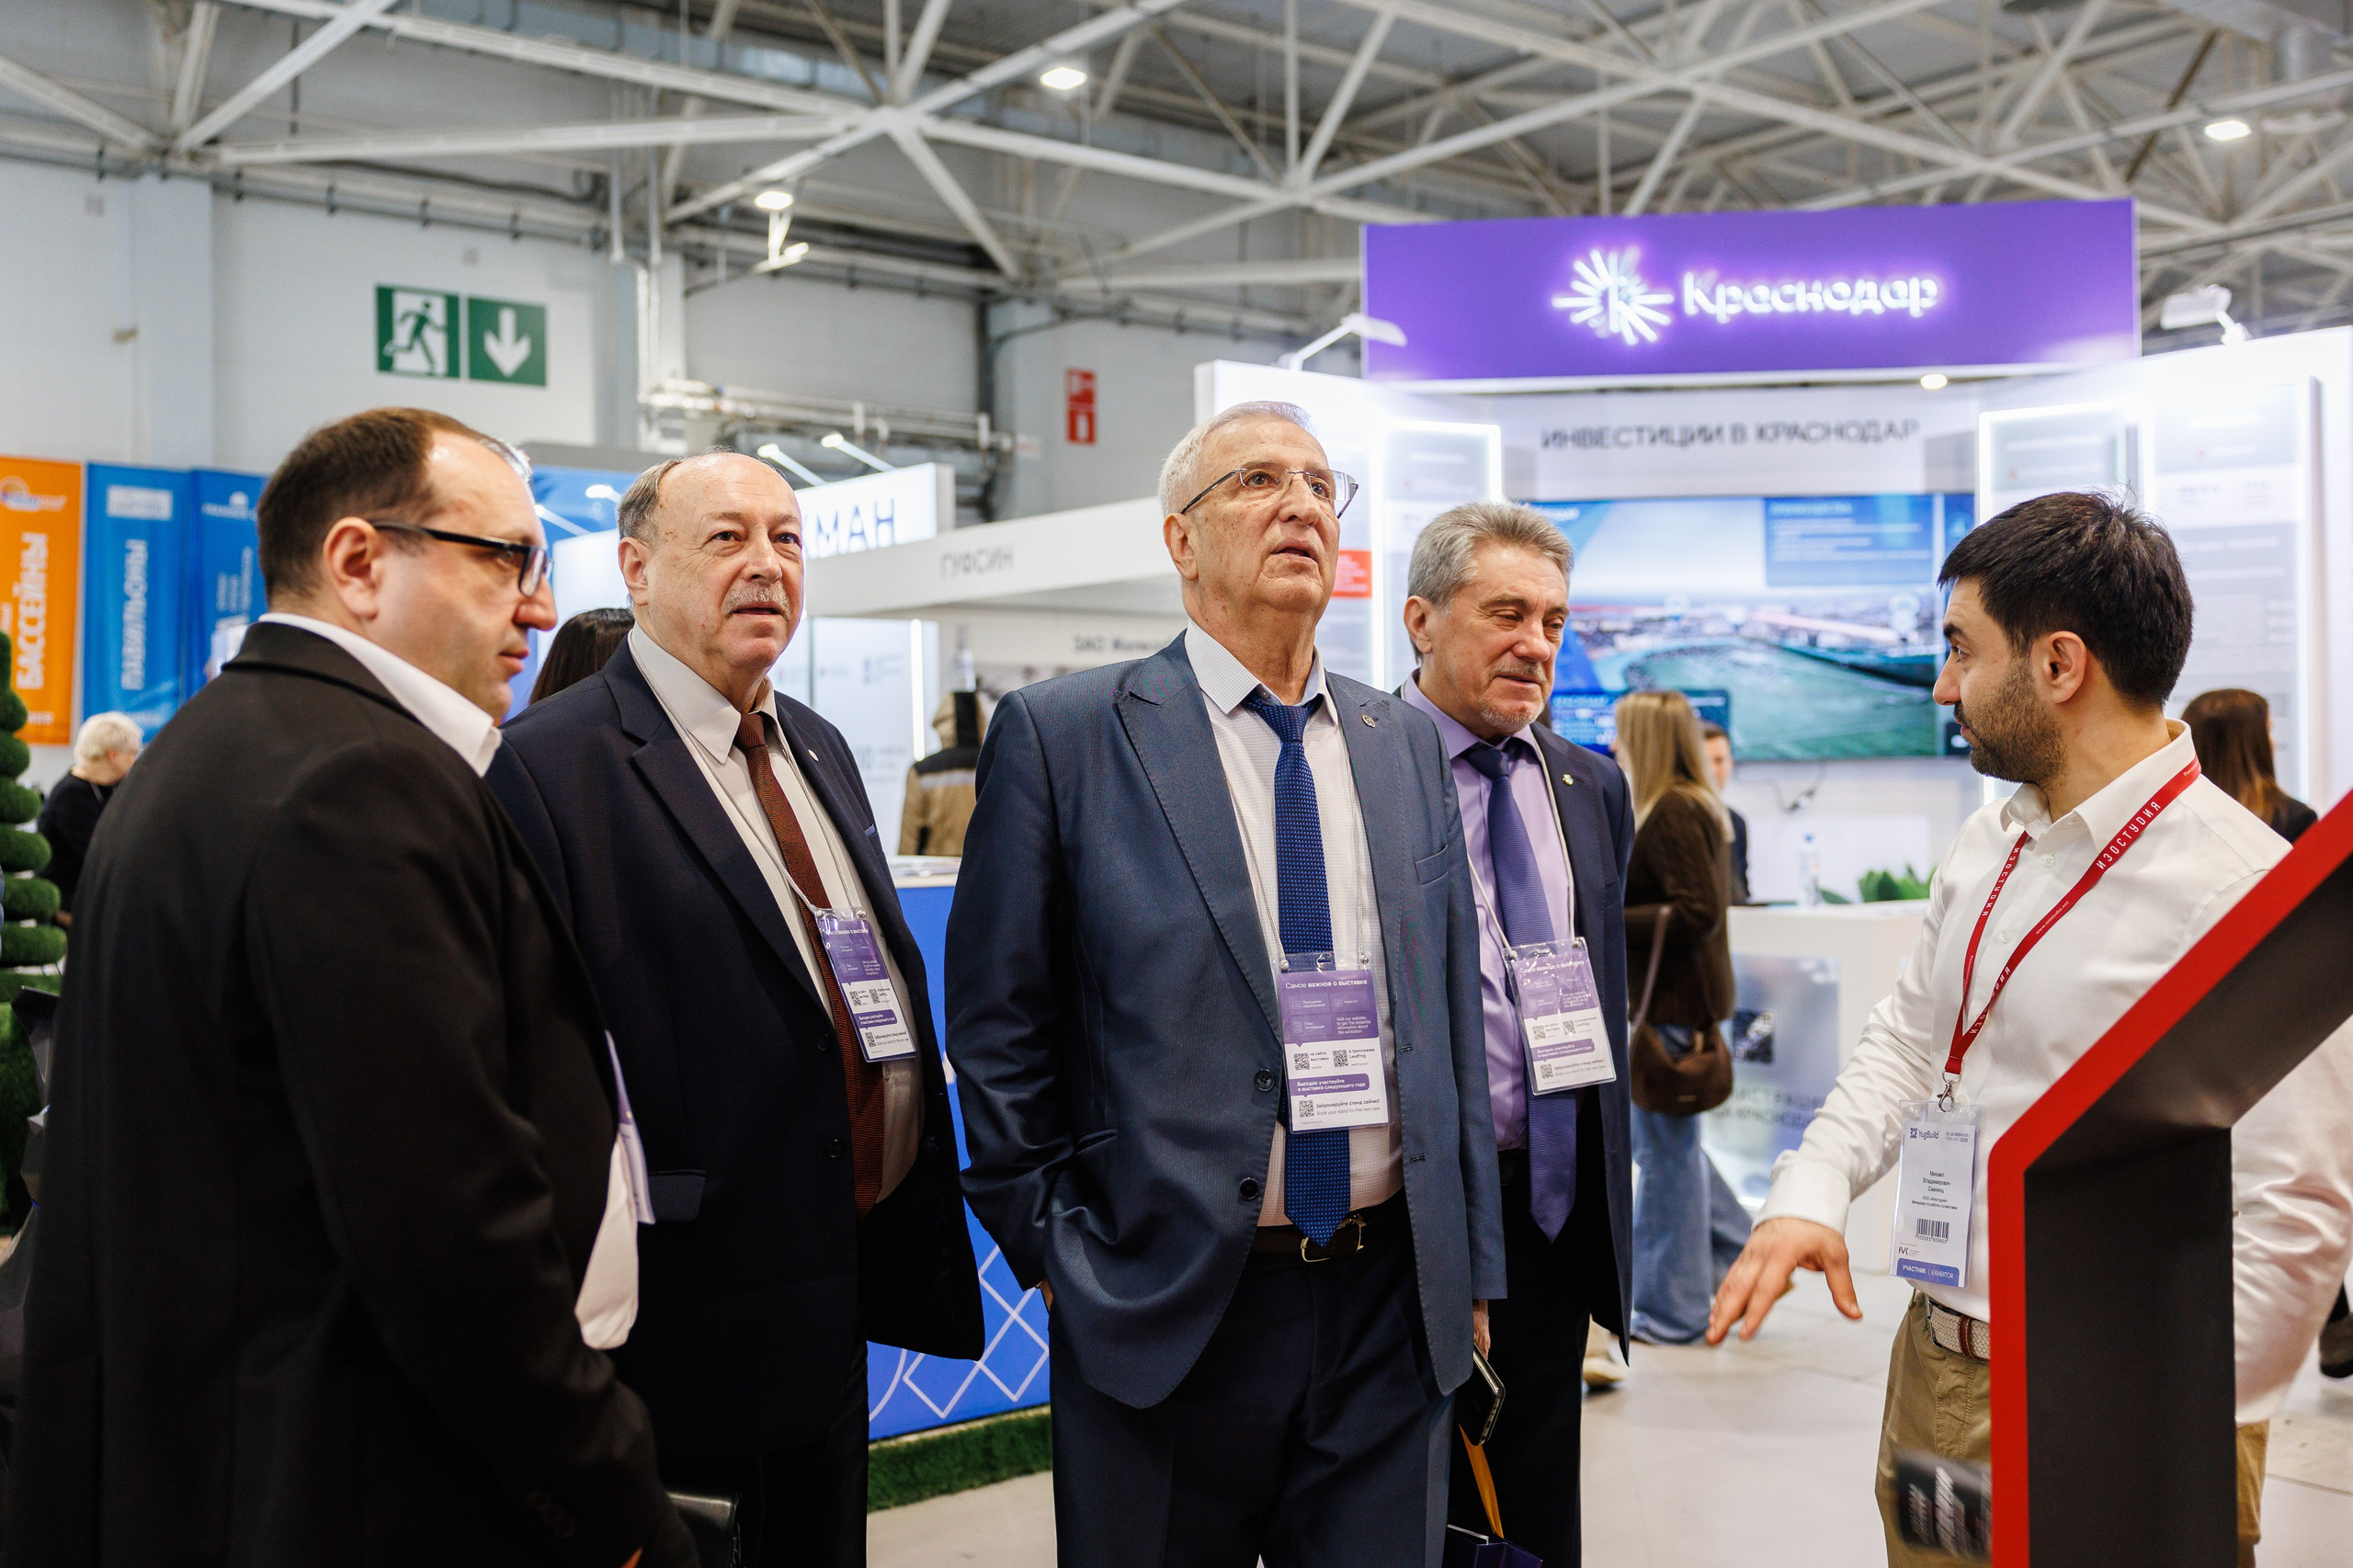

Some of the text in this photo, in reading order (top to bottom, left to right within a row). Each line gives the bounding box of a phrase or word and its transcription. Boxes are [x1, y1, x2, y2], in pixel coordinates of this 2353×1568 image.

[1684, 271, 1938, 324] Краснодар
[1540, 418, 1919, 451] ИНВЕСТИЦИИ В КРАСНОДАР
[13, 531, 48, 689] БАССЕЙНЫ
[1919, 1131, 1939, 1140] YugBuild
[1923, 1177, 1951, 1186] Владимирович
[1903, 1265, 1927, 1274] УЧАСТНИК
[1931, 1269, 1954, 1278] EXHIBITOR
